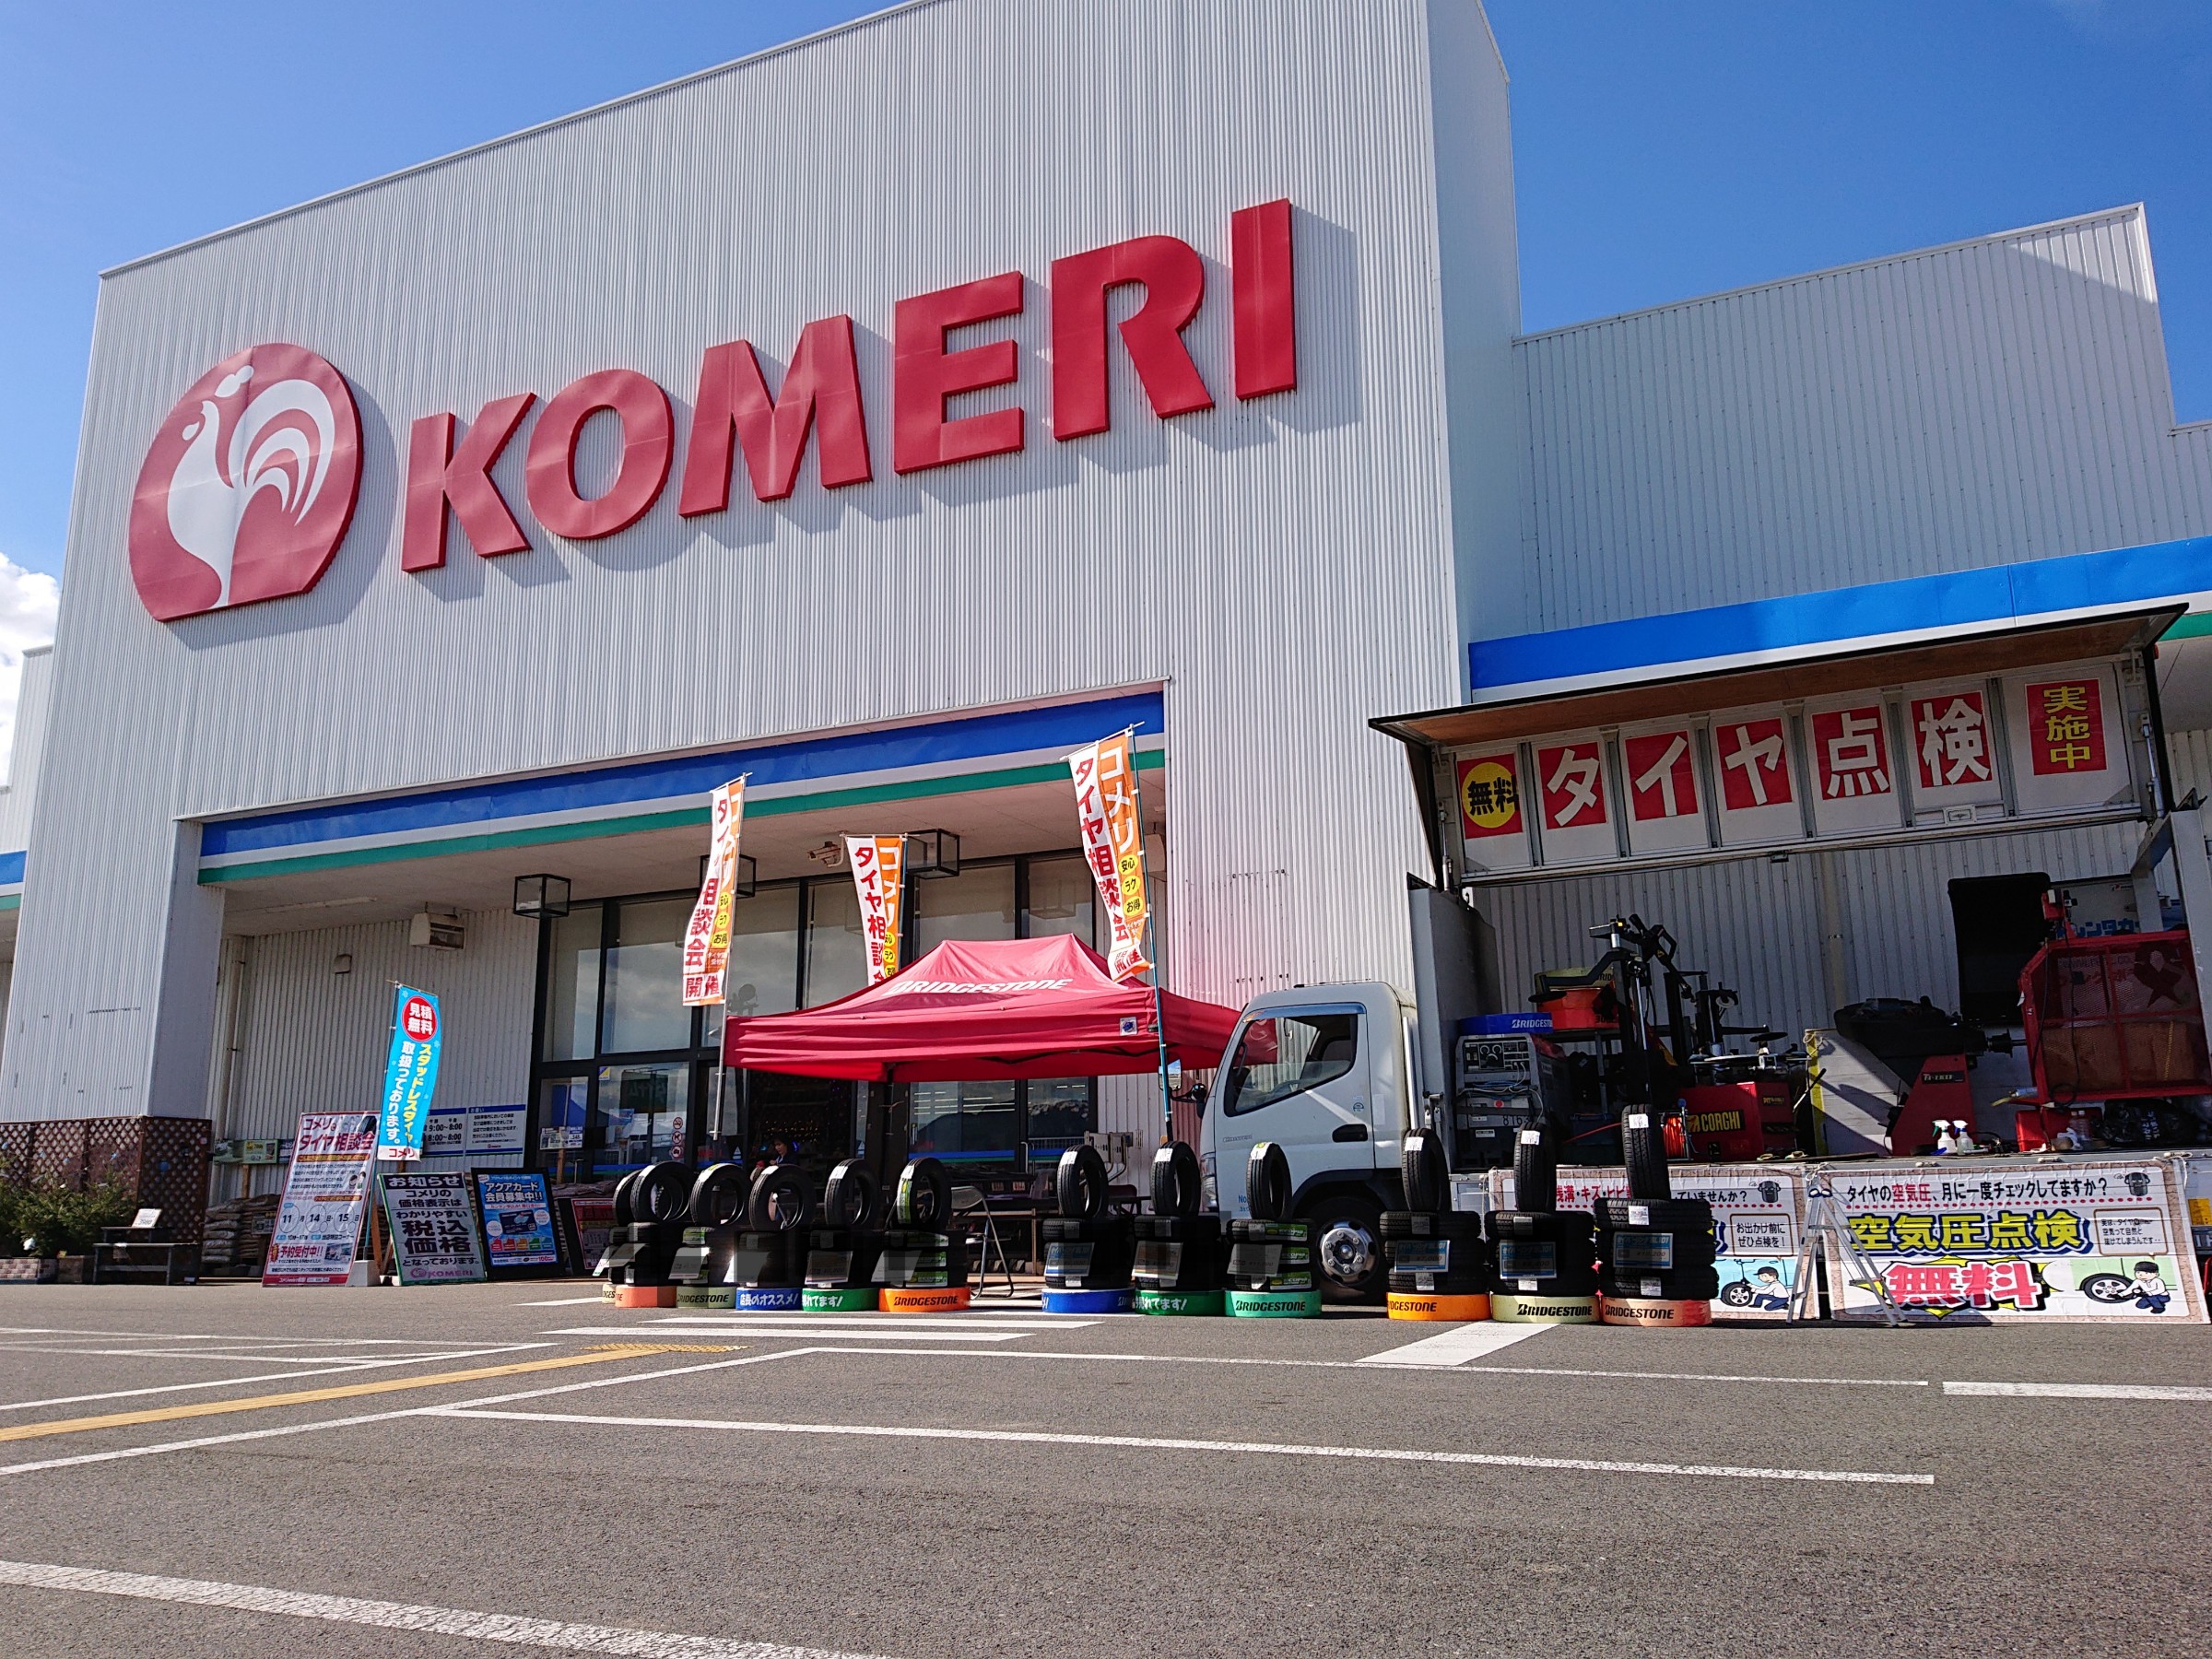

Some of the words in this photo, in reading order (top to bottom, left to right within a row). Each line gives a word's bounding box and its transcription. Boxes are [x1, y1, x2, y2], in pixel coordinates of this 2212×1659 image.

[400, 199, 1296, 572] KOMERI
[2043, 685, 2092, 771] 実施中
[1100, 747, 1135, 853] コメリ
[1467, 774, 1519, 816] 無料
[1121, 857, 1135, 873] 安心
[879, 847, 900, 927] コメリ
[1125, 877, 1136, 892] ラク
[1126, 899, 1140, 912] お得
[686, 975, 720, 998] 開催
[881, 978, 1073, 996] BRIDGESTONE
[408, 1002, 432, 1019] 見積
[407, 1018, 433, 1035] 無料
[1701, 1111, 1741, 1133] CORGHI
[299, 1132, 376, 1152] タイヤ相談会
[388, 1148, 416, 1158] コメリ
[389, 1176, 460, 1187] お知らせ
[485, 1182, 538, 1192] アクアカード
[406, 1189, 452, 1198] コメリの
[485, 1191, 543, 1202] 会員募集中!!
[398, 1198, 463, 1208] 価格表示は
[396, 1210, 468, 1218] わかりやすい
[401, 1219, 469, 1237] 税込
[1736, 1223, 1786, 1233] お出かけ前に
[1849, 1208, 2083, 1251] 空気圧点検
[2102, 1228, 2144, 1236] 空気って自然と
[405, 1236, 471, 1254] 価格
[403, 1257, 479, 1266] となっております。
[1886, 1262, 2043, 1307] 無料
[894, 1295, 959, 1306] BRIDGESTONE
[1235, 1300, 1306, 1312] BRIDGESTONE
[1517, 1303, 1593, 1316] BRIDGESTONE
[1605, 1304, 1675, 1320] BRIDGESTONE
